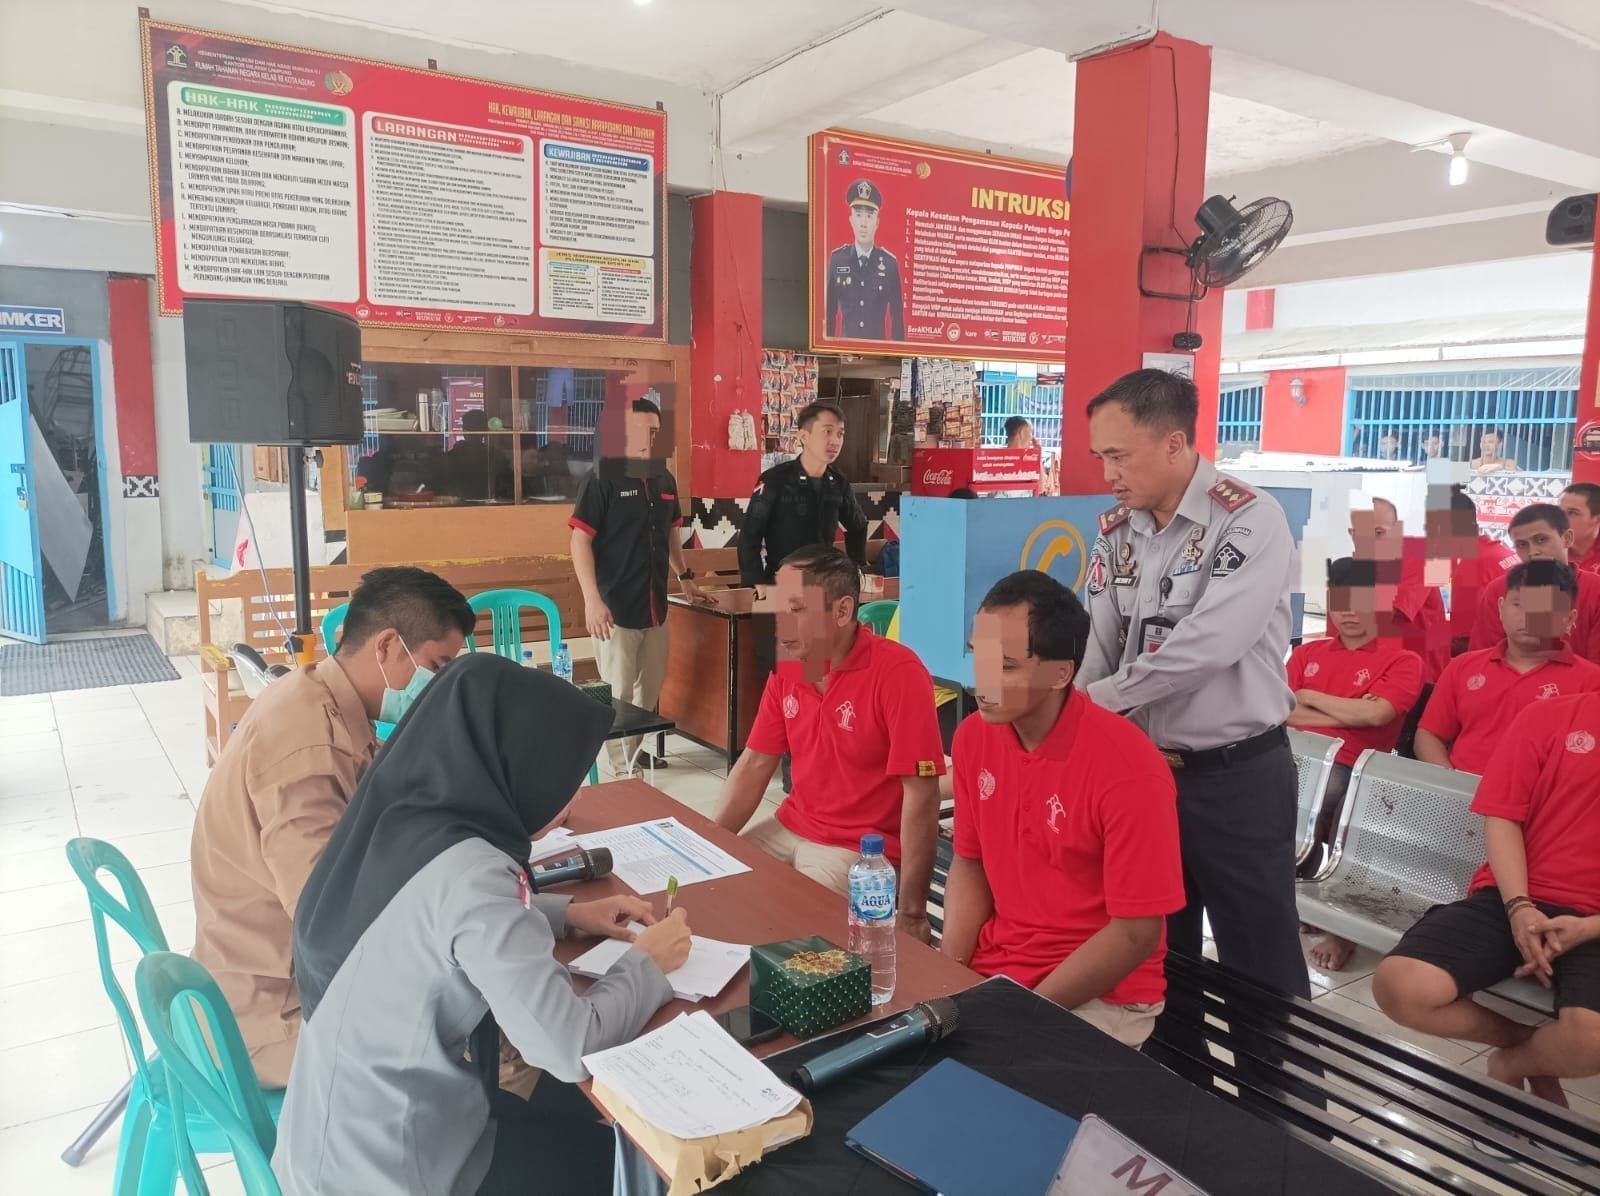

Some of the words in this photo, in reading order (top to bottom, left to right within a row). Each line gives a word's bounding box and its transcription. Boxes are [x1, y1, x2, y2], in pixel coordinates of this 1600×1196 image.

[184, 91, 259, 112] HAK-HAK
[376, 121, 457, 142] LARANGAN
[549, 148, 591, 162] KEWAJIBAN
[972, 188, 1070, 220] INTRUKSI
[907, 208, 929, 220] Kepala
[1001, 220, 1023, 231] Kepada
[1024, 222, 1047, 234] Petugas
[862, 895, 891, 909] AQUA
